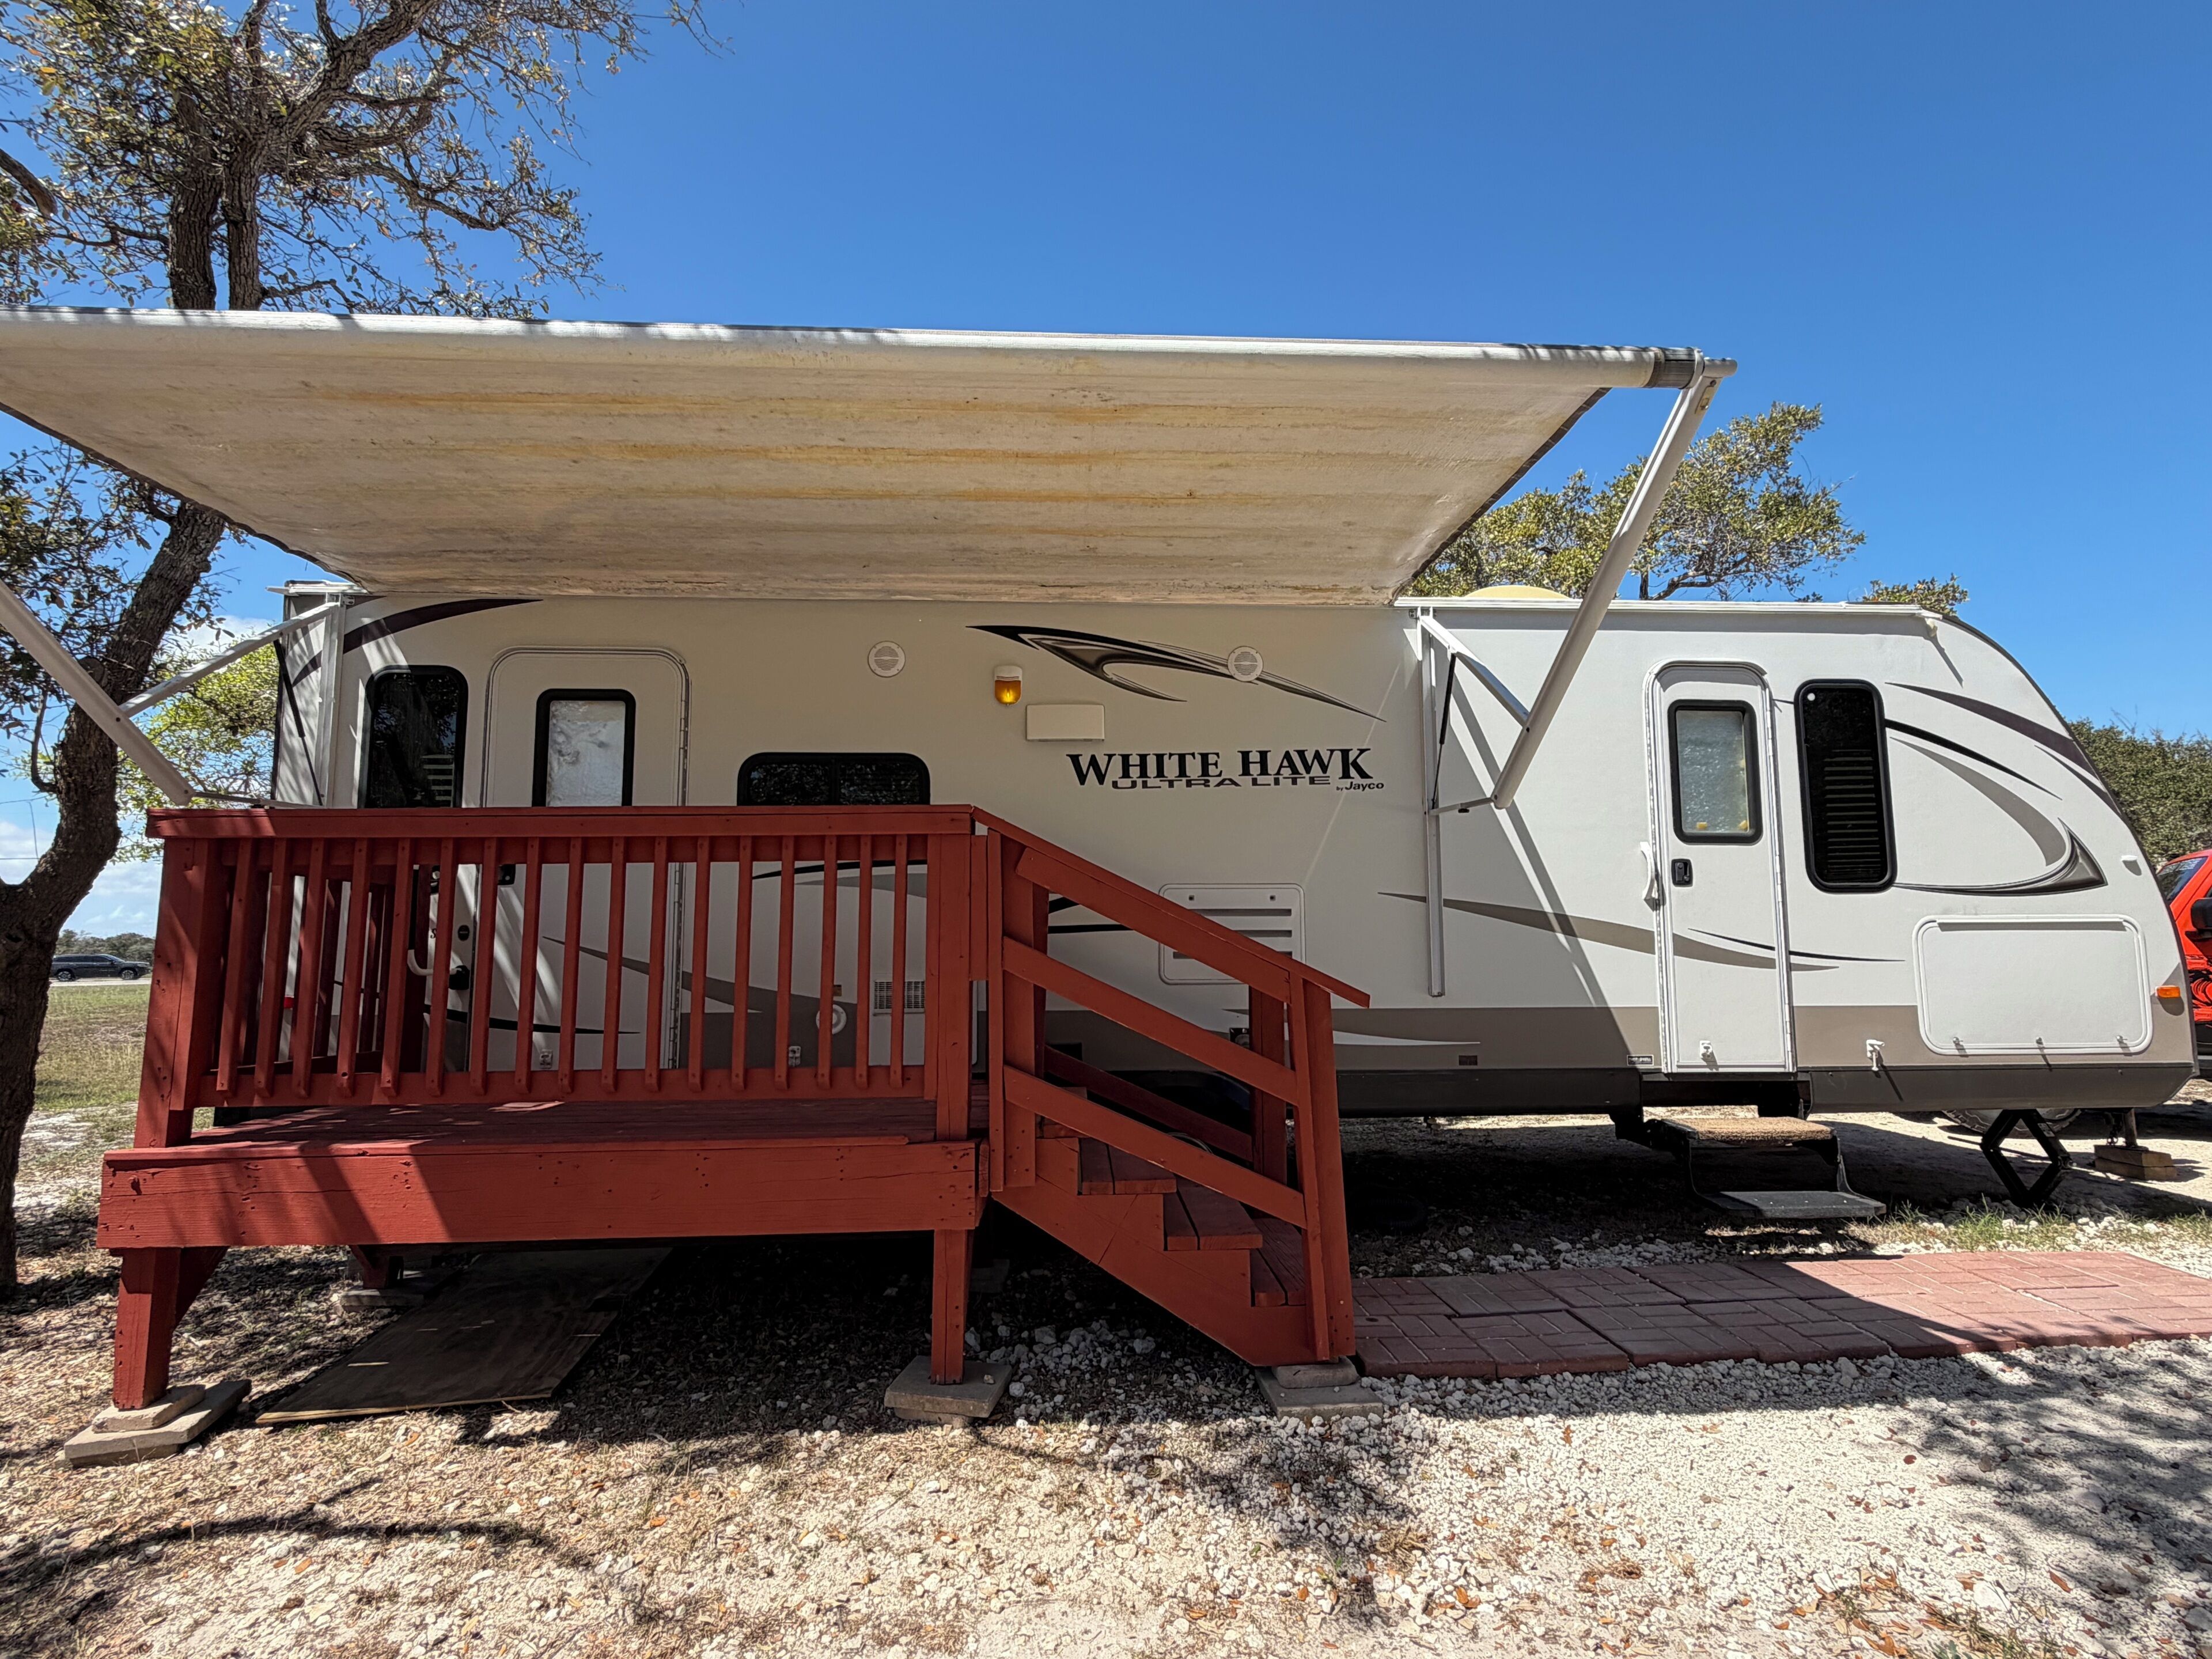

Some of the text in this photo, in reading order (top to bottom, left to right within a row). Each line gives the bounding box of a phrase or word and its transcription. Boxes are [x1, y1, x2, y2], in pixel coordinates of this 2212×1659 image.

[1066, 748, 1373, 786] WHITE HAWK
[1112, 776, 1330, 789] ULTRA LITE
[1344, 781, 1384, 791] Jayco
